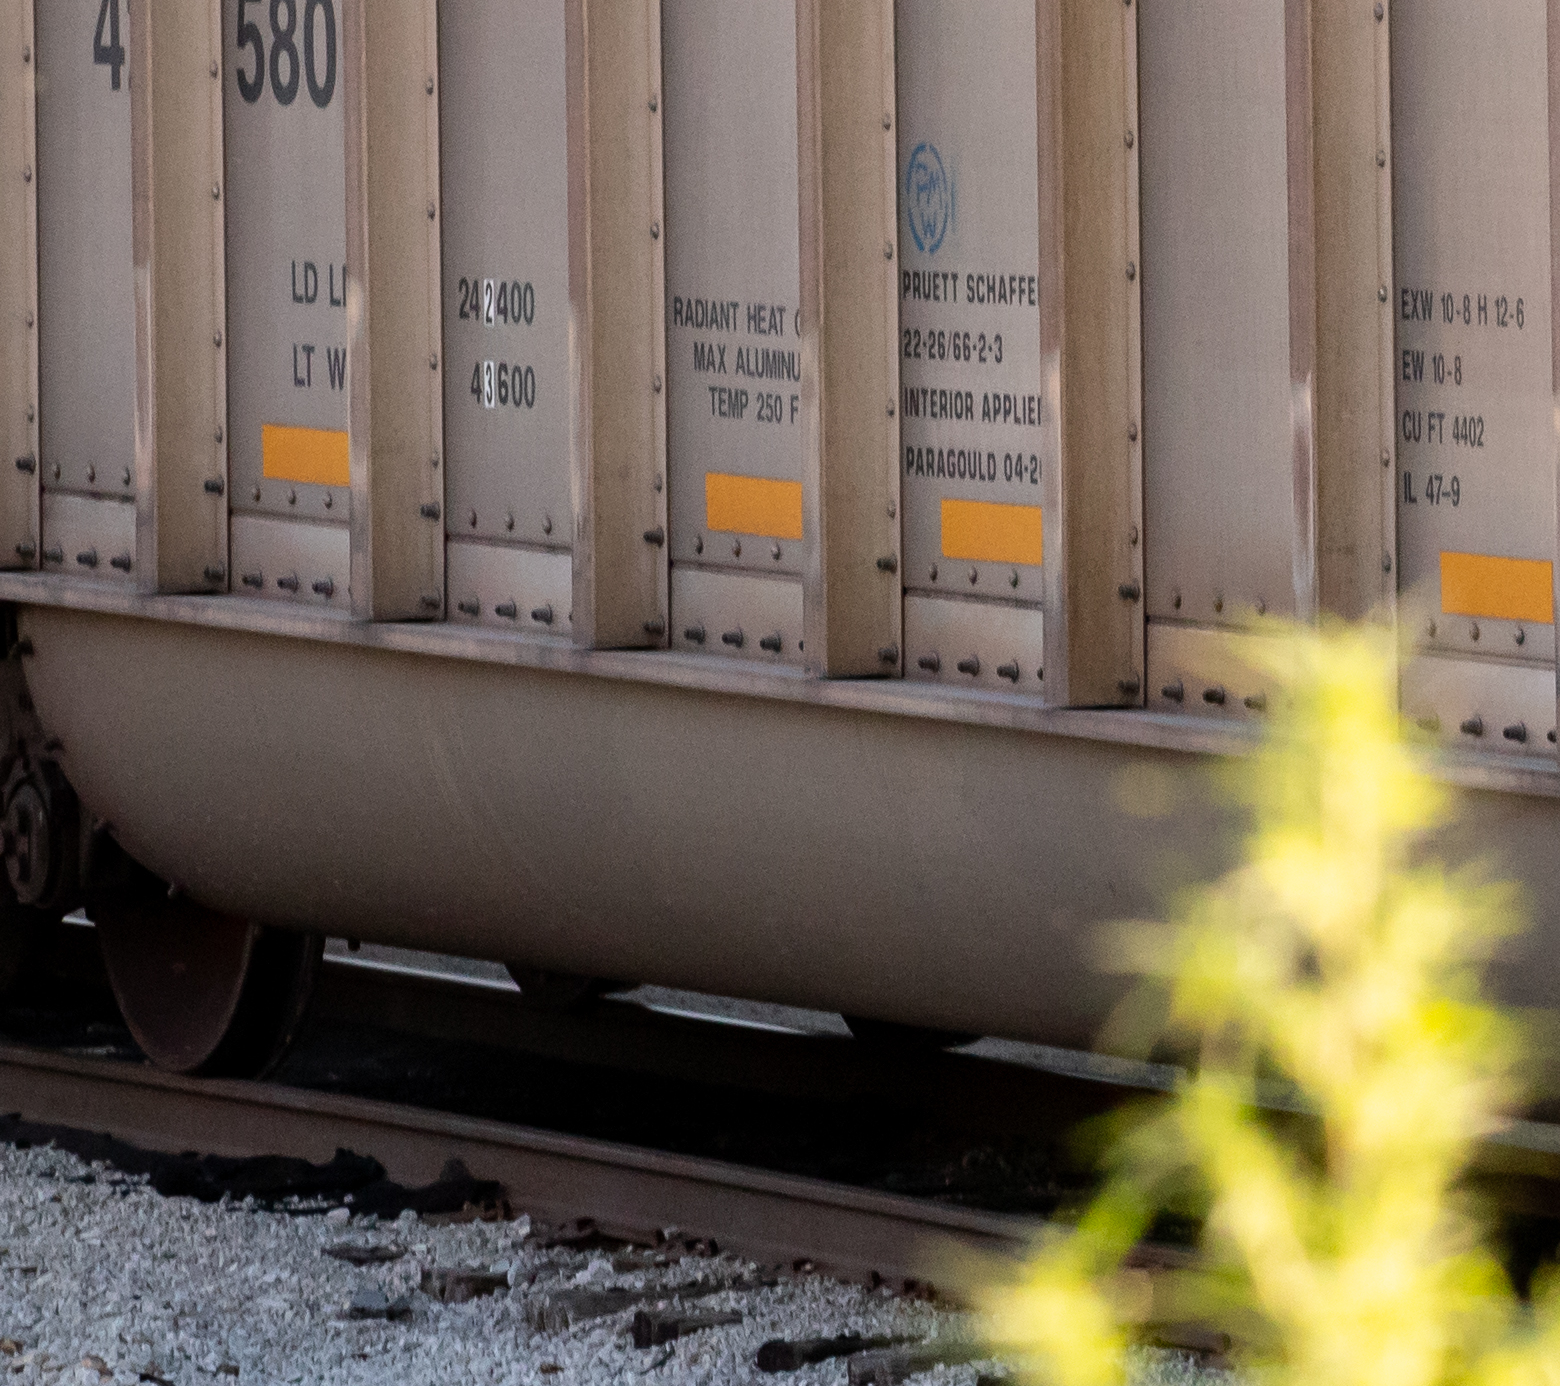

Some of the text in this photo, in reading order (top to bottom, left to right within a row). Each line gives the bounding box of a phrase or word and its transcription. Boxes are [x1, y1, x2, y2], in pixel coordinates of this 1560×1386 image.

[291, 260, 318, 304] LD
[459, 276, 535, 325] 242400
[902, 270, 1040, 306] PRUETT SCHAFFE
[673, 296, 739, 332] RADIANT
[747, 303, 786, 337] HEAT
[1401, 288, 1525, 330] EXW 10-8 H 12-6
[293, 343, 315, 388] LT
[693, 341, 727, 375] MAX
[1402, 350, 1462, 387] EW 10-8
[470, 360, 536, 409] 43600
[708, 386, 749, 420] TEMP
[756, 392, 783, 424] 250
[904, 387, 1041, 425] INTERIOR APPLIE
[1402, 410, 1484, 448] CU FT 4402
[906, 445, 1042, 485] PARAGOULD 04-2
[1403, 470, 1460, 508] IL 47-9
